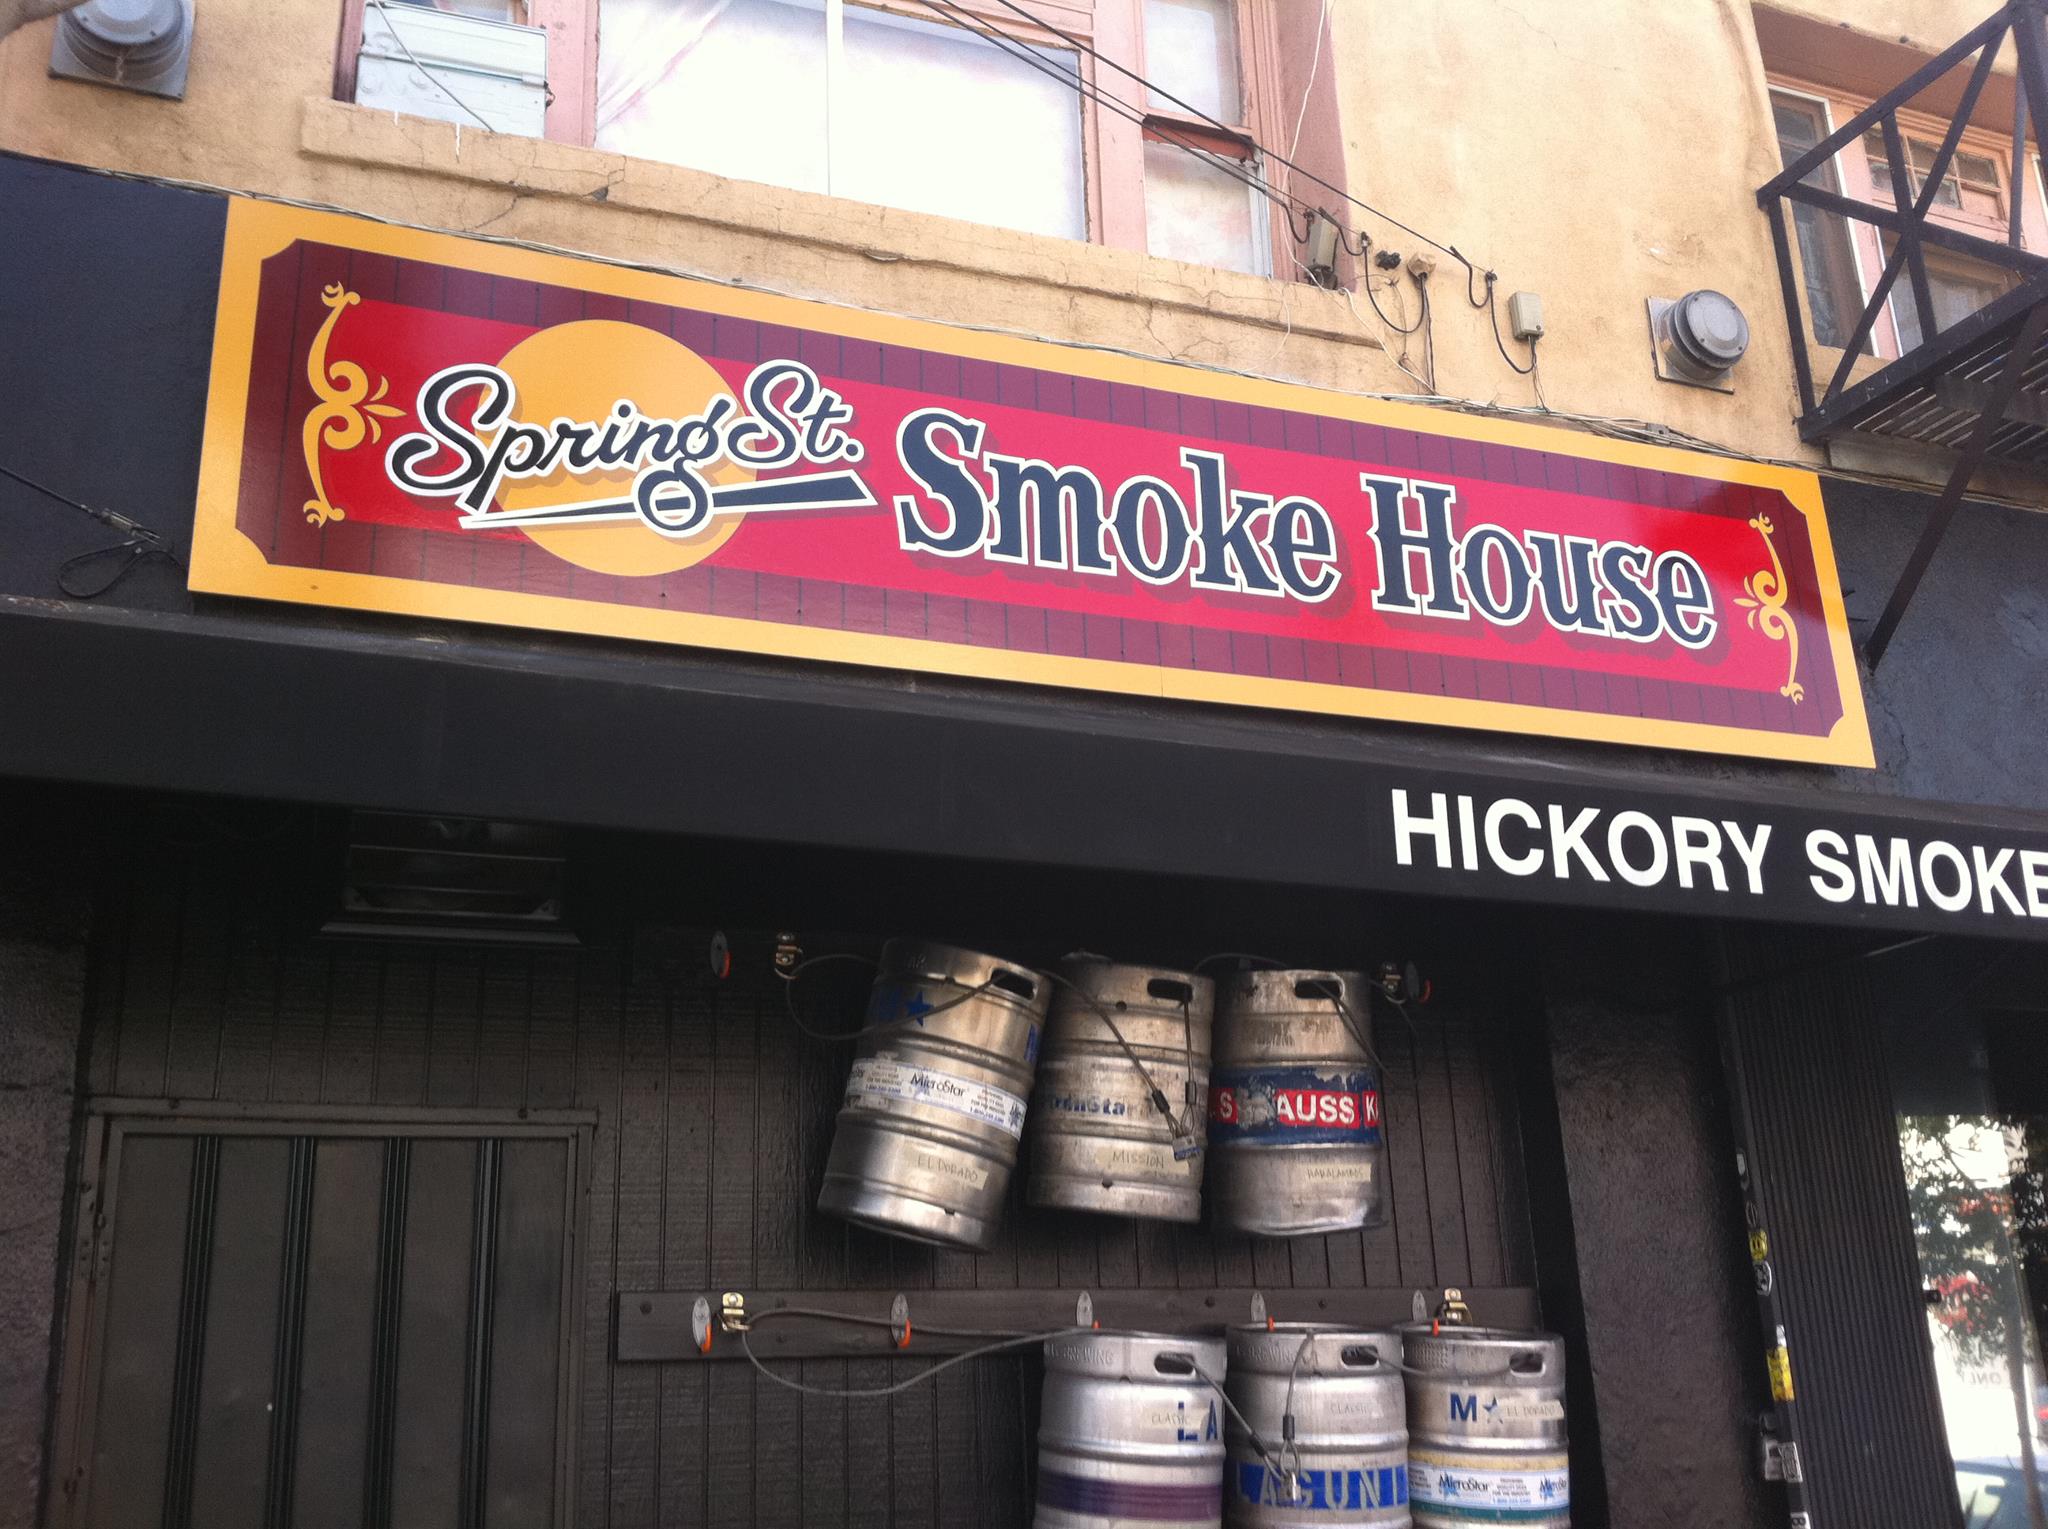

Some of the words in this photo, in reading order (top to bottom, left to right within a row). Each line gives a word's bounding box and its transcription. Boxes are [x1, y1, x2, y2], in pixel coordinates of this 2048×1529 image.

[385, 363, 734, 539] Spring
[727, 358, 866, 470] St.
[894, 406, 1342, 604] Smoke
[1357, 471, 1719, 651] House
[1391, 788, 1772, 895] HICKORY
[1804, 828, 2048, 919] SMOKE
[1112, 1150, 1164, 1169] MISSION
[1439, 1472, 1490, 1495] MicroStar
